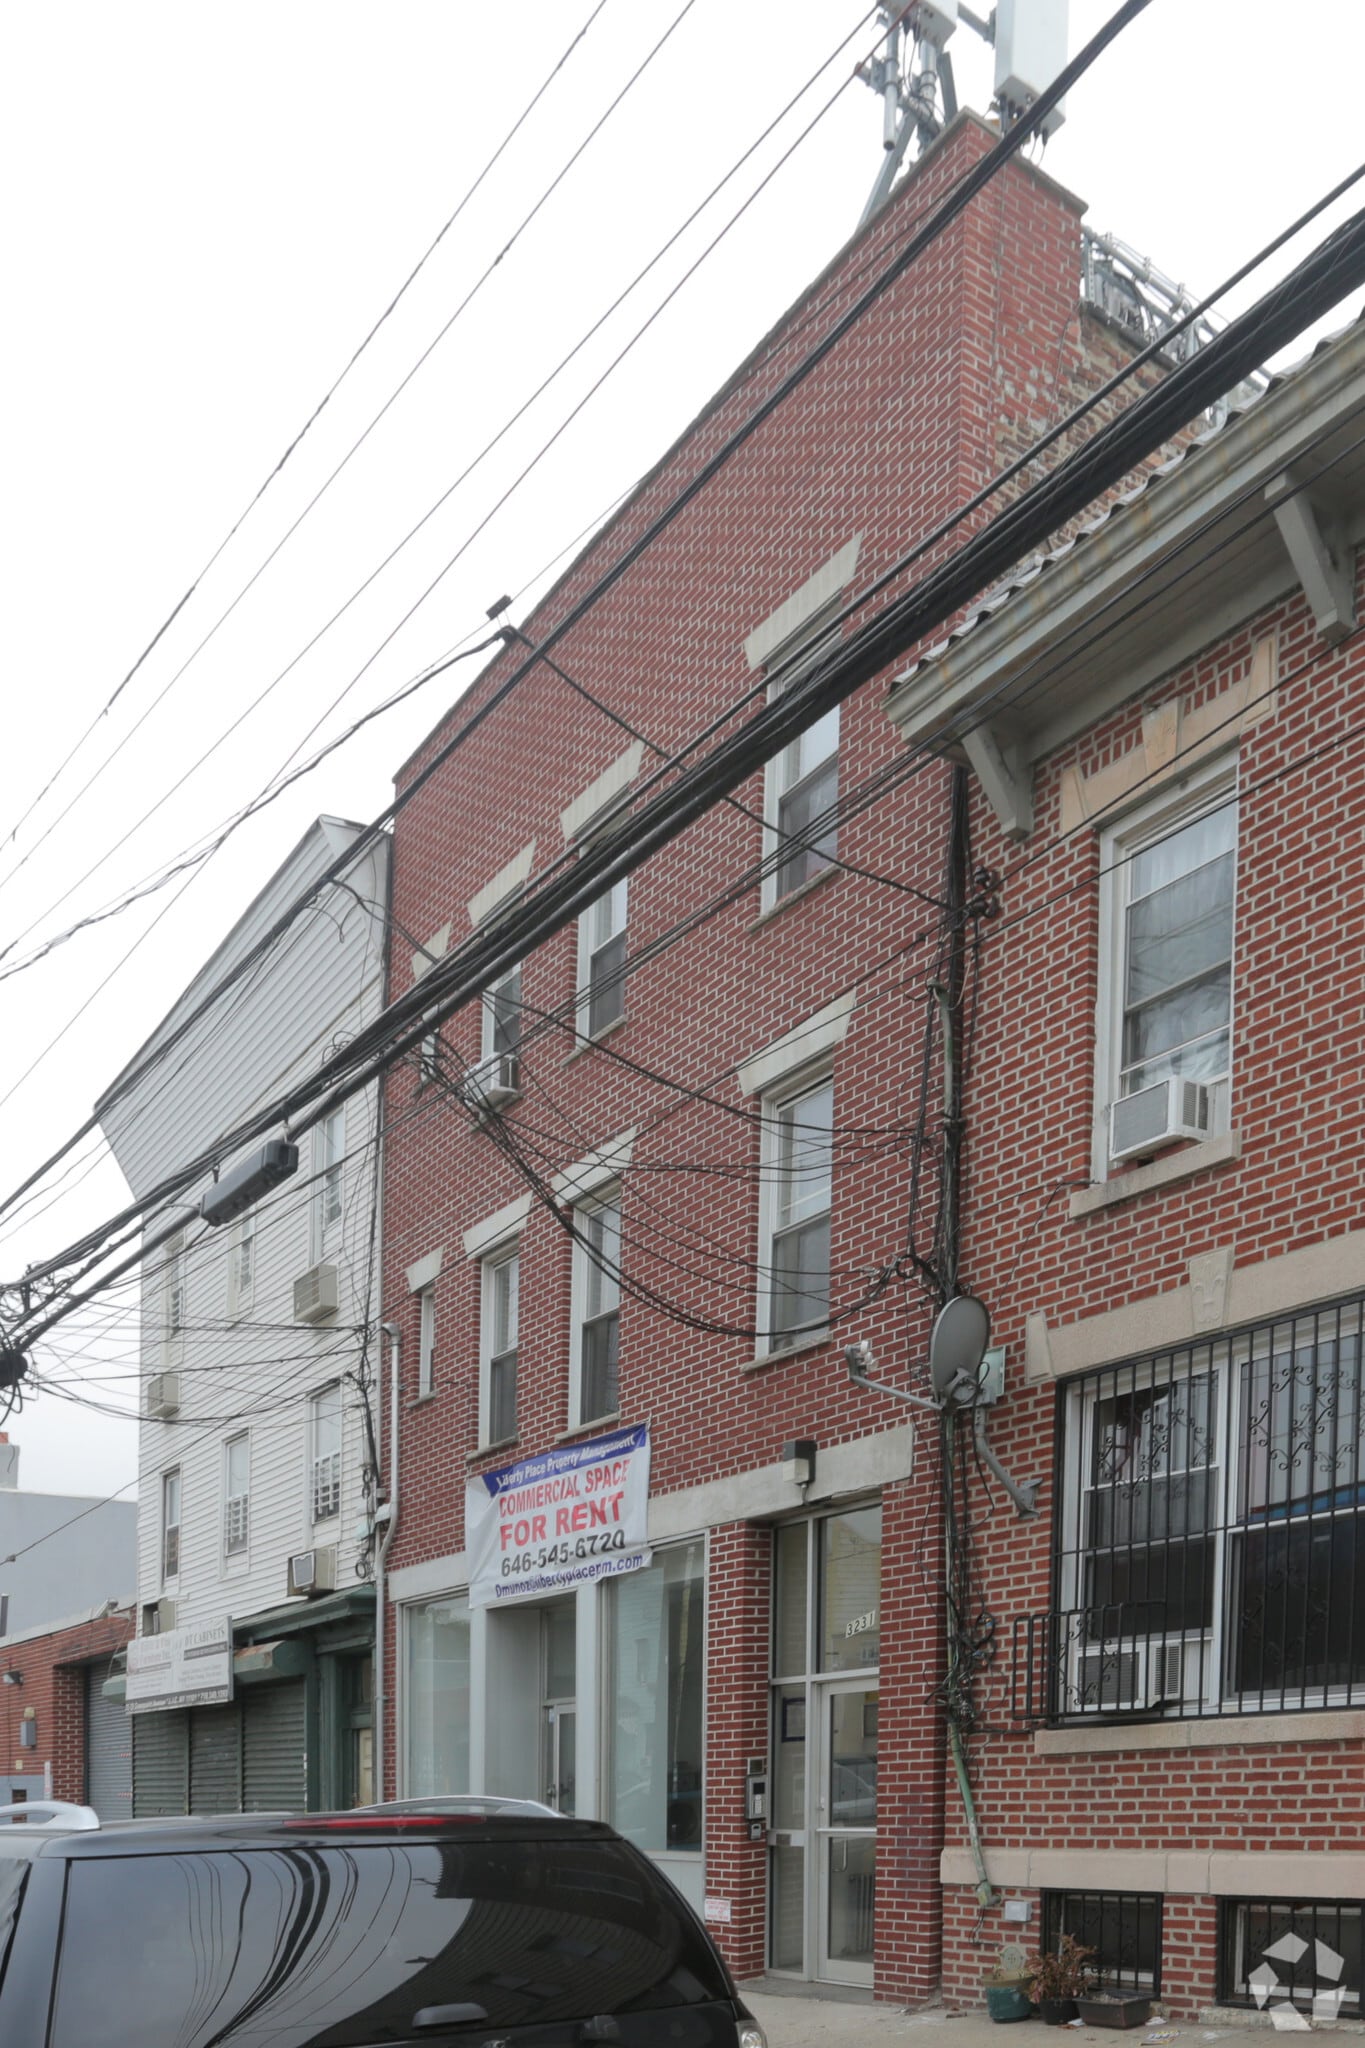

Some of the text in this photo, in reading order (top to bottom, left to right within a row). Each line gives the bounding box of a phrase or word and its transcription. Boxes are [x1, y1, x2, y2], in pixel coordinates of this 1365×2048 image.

[525, 1463, 546, 1478] Place
[547, 1454, 579, 1470] Property
[580, 1434, 635, 1459] Management
[499, 1459, 631, 1518] COMMERCIAL SPACE
[499, 1491, 625, 1551] FOR RENT
[501, 1529, 626, 1577] 646-545-6720
[847, 1613, 873, 1636] 3231
